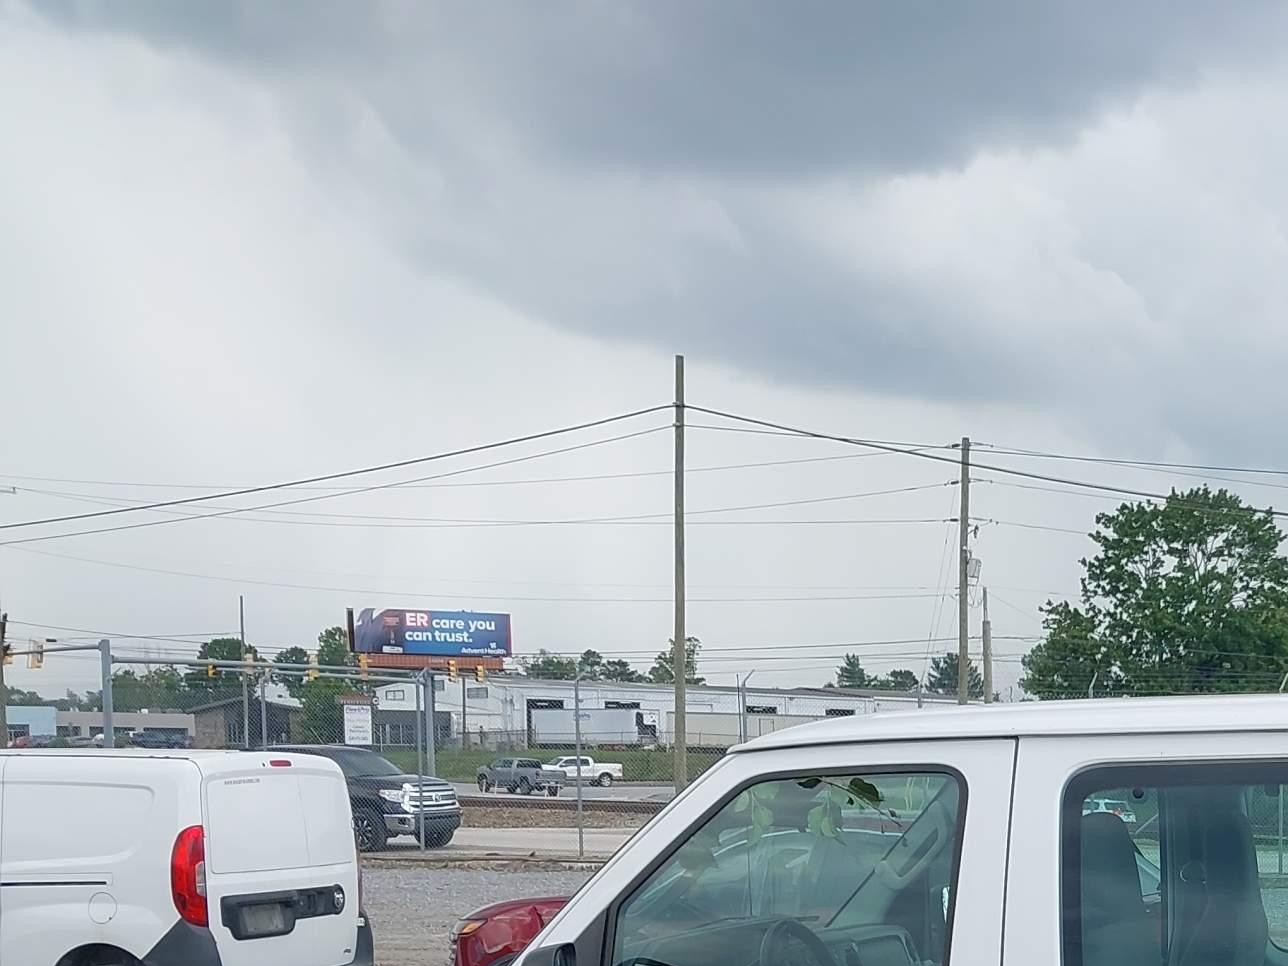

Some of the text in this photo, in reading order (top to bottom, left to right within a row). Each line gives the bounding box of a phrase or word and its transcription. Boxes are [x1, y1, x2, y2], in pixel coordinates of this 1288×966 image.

[405, 612, 429, 627] ER
[432, 618, 464, 629] care
[468, 619, 496, 633] you
[405, 630, 473, 643] can trust.
